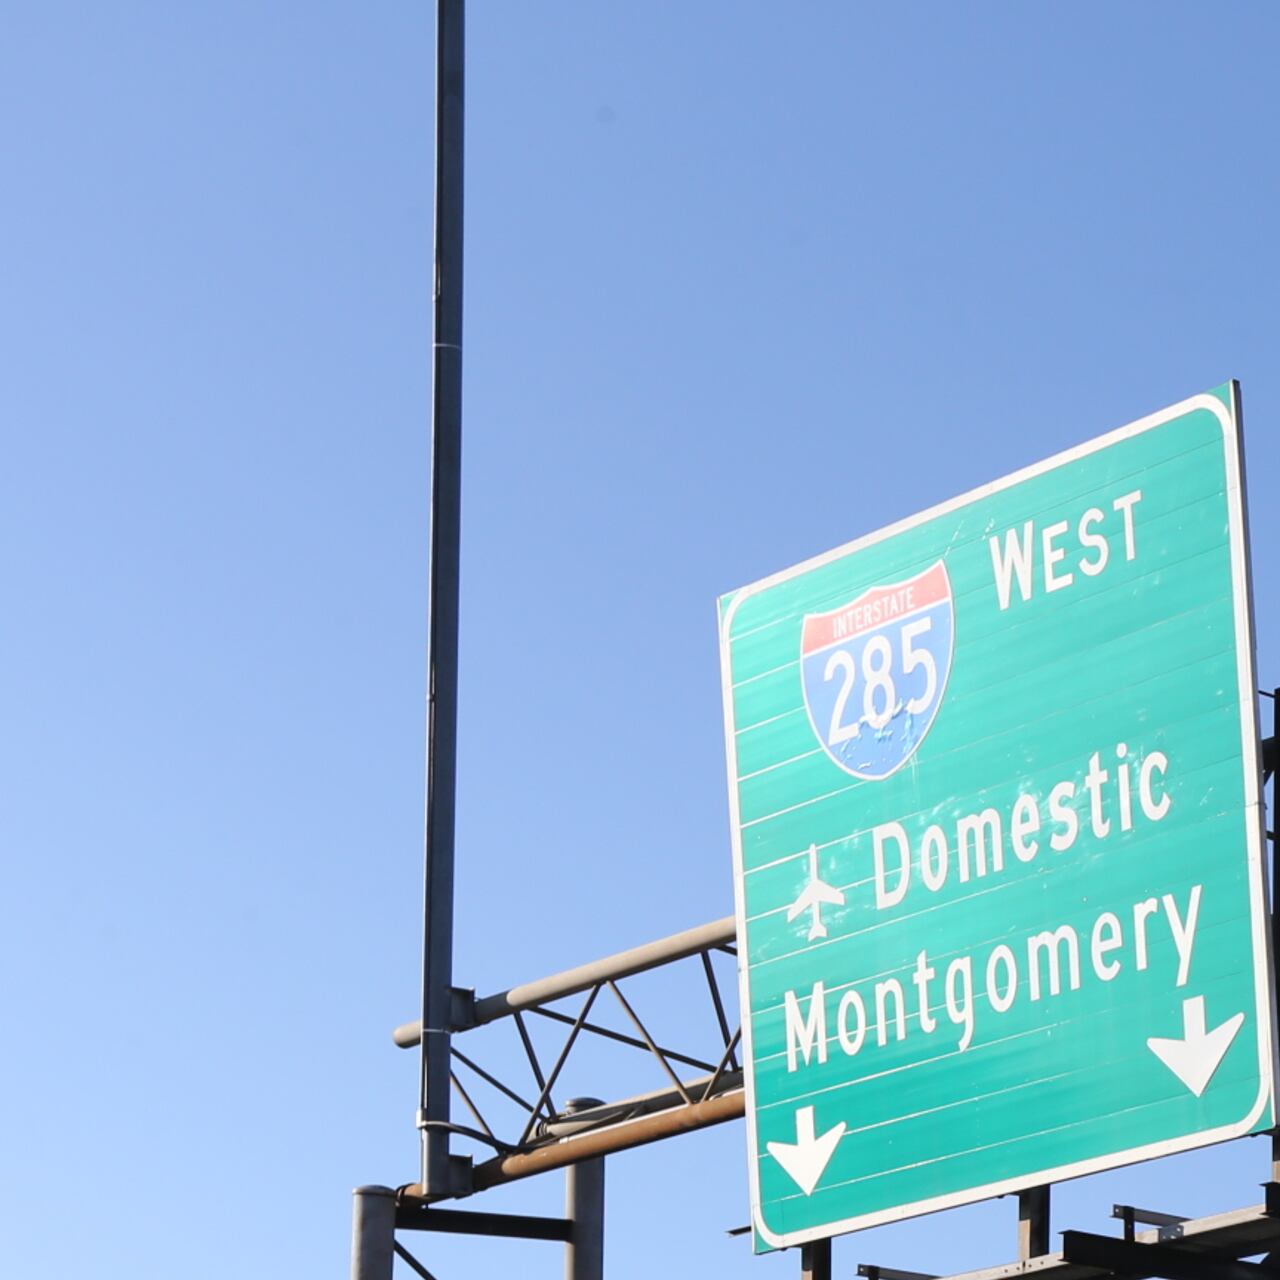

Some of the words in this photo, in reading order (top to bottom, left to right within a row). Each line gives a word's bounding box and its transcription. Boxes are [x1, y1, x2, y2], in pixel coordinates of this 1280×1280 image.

[832, 585, 915, 638] INTERSTATE
[988, 489, 1143, 611] WEST
[821, 618, 938, 747] 285
[872, 742, 1172, 910] Domestic
[784, 884, 1203, 1073] Montgomery
